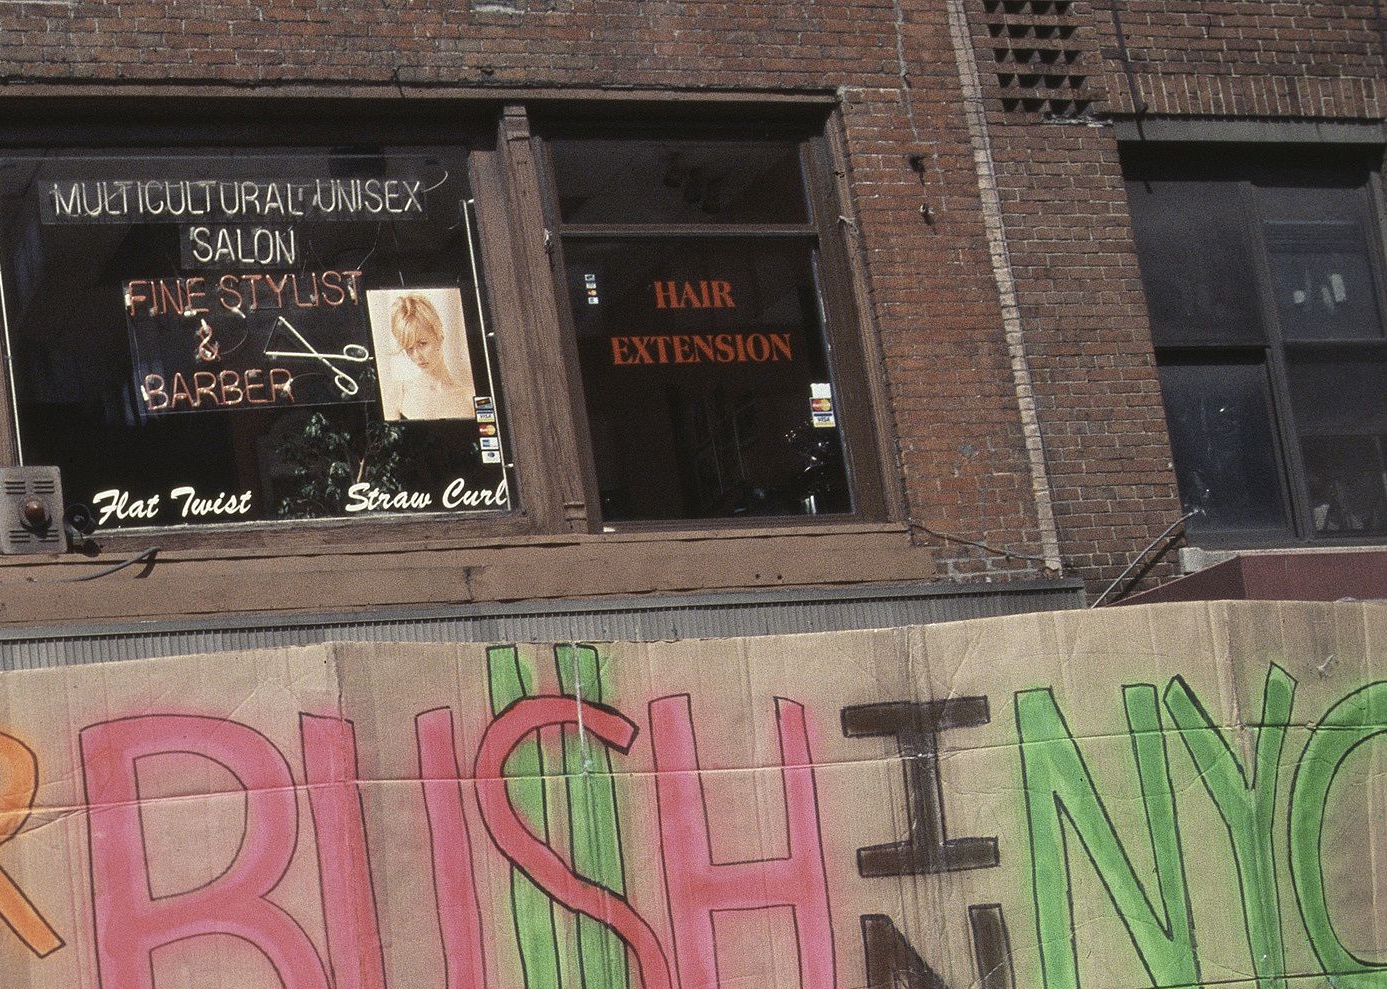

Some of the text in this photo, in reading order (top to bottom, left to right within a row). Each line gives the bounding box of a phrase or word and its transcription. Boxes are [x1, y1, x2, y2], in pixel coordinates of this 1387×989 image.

[51, 178, 422, 216] MULTICULTURAL UNISEX
[191, 227, 295, 264] SALON
[127, 270, 362, 317] FINE STYLIST
[653, 279, 736, 309] HAIR
[196, 320, 221, 361] &
[611, 333, 793, 366] EXTENSION
[143, 368, 294, 411] BARBER
[93, 485, 253, 525] Flat Twist
[345, 477, 508, 512] Straw Curl
